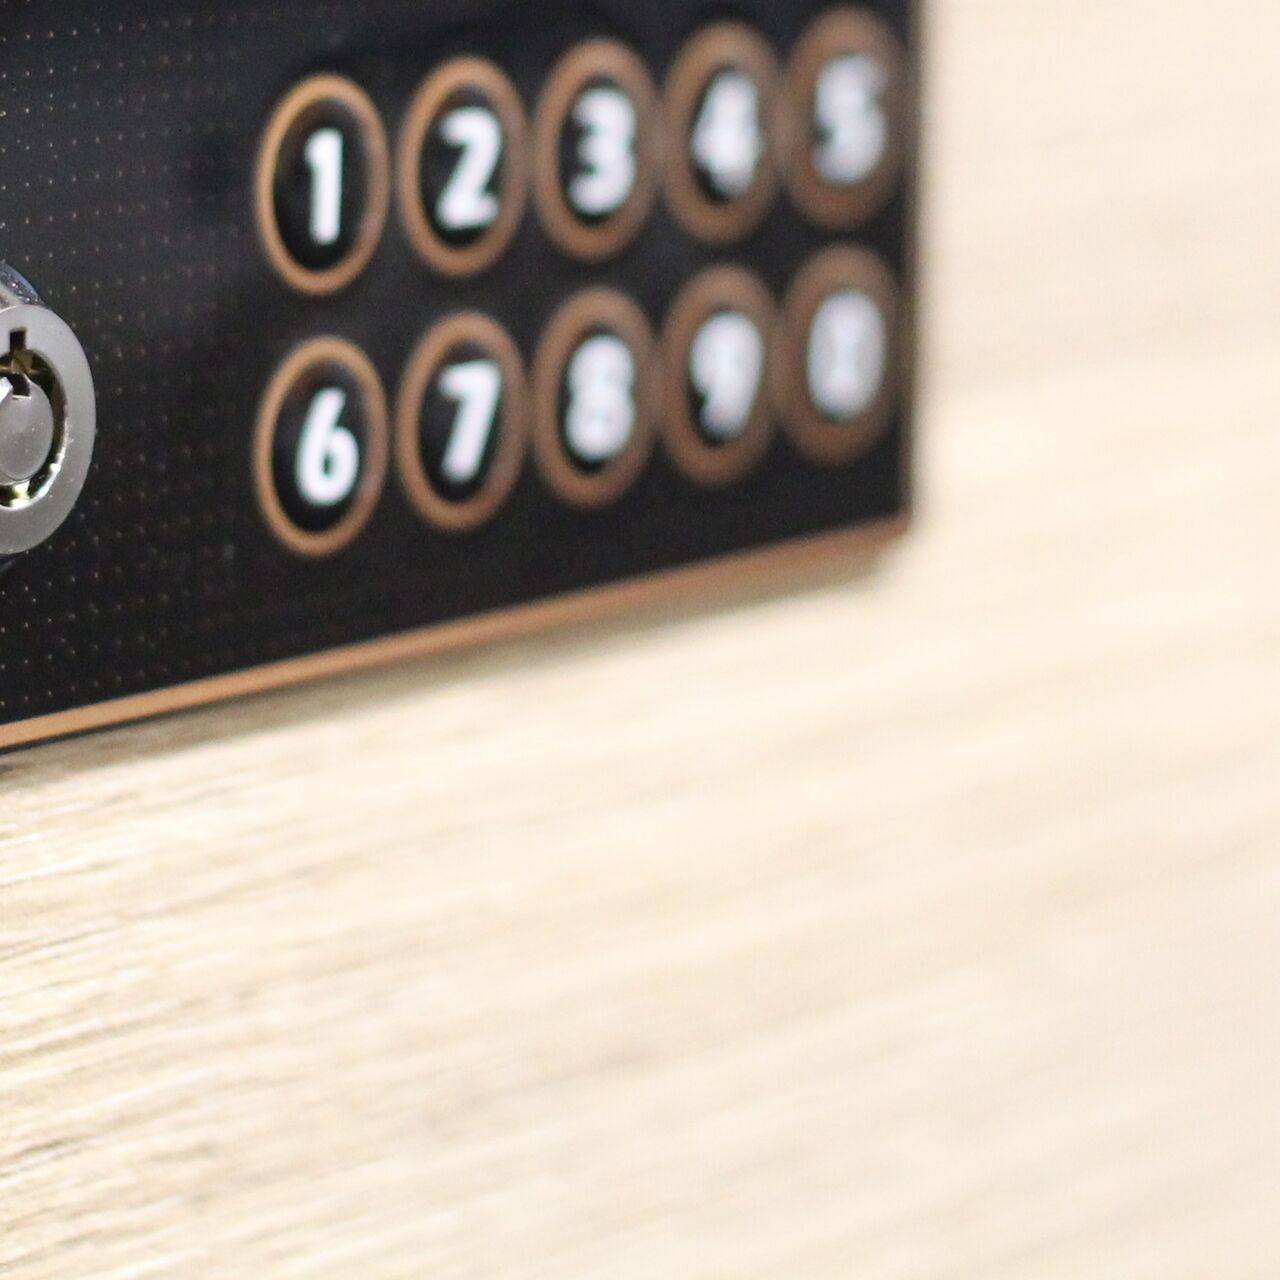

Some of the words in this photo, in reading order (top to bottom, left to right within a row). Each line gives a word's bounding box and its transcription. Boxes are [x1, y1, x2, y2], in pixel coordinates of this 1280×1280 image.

[305, 129, 343, 244] 1
[437, 107, 503, 229] 2
[569, 87, 637, 215] 3
[690, 68, 761, 196] 4
[812, 53, 887, 184] 5
[296, 388, 360, 505] 6
[439, 360, 502, 483] 7
[566, 335, 636, 461] 8
[688, 310, 764, 436] 9
[806, 287, 886, 419] 0
